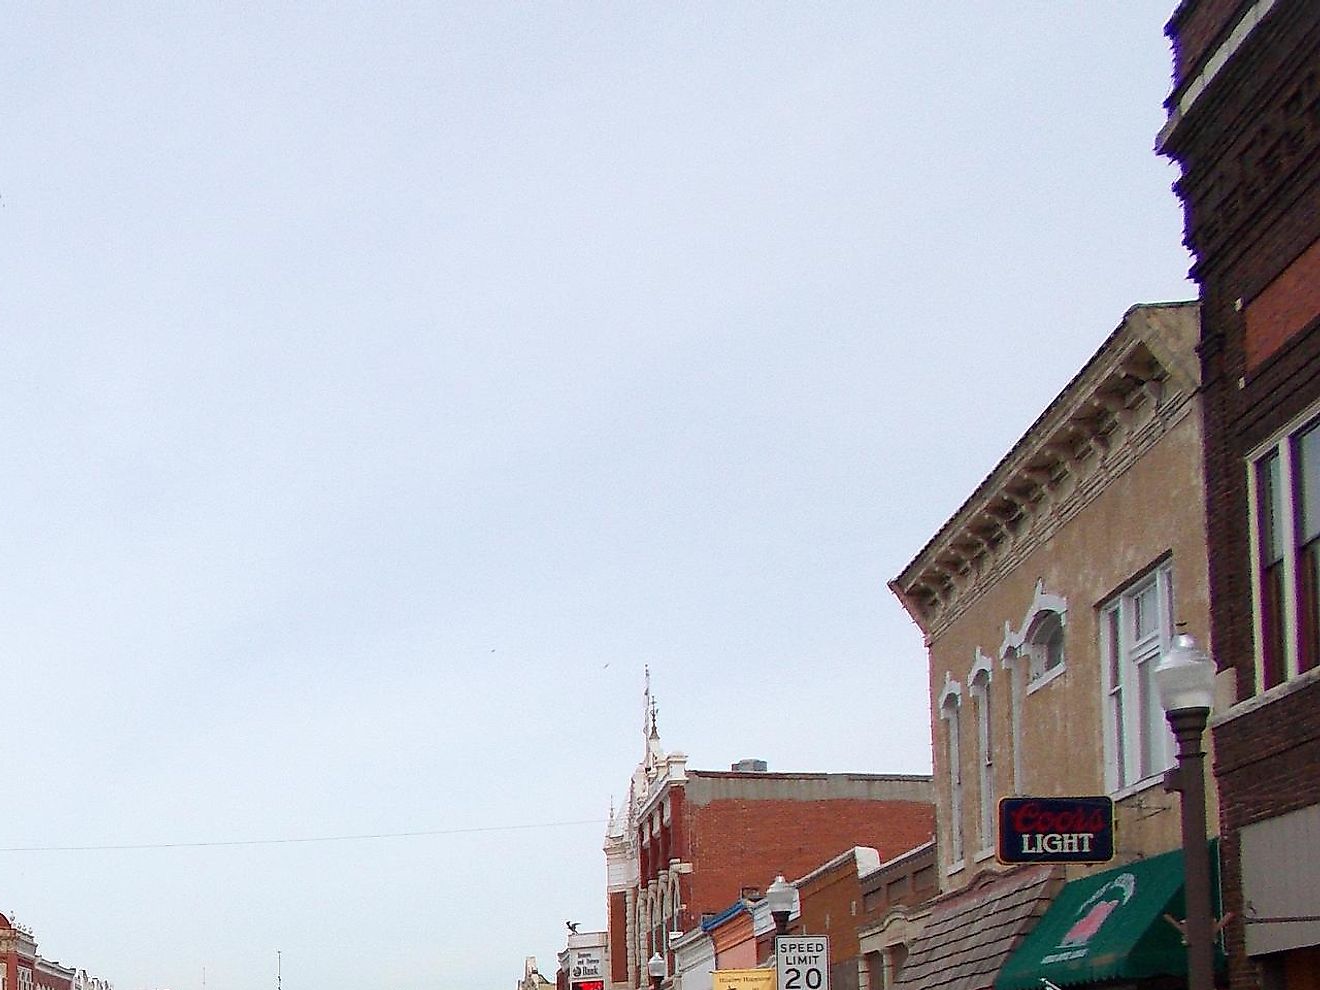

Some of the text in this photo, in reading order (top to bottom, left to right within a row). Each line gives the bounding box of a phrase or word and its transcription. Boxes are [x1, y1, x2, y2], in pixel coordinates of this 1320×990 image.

[1012, 803, 1105, 831] Coors
[1021, 833, 1094, 853] LIGHT
[780, 943, 824, 953] SPEED
[786, 956, 820, 965] LIMIT
[785, 968, 822, 989] 20
